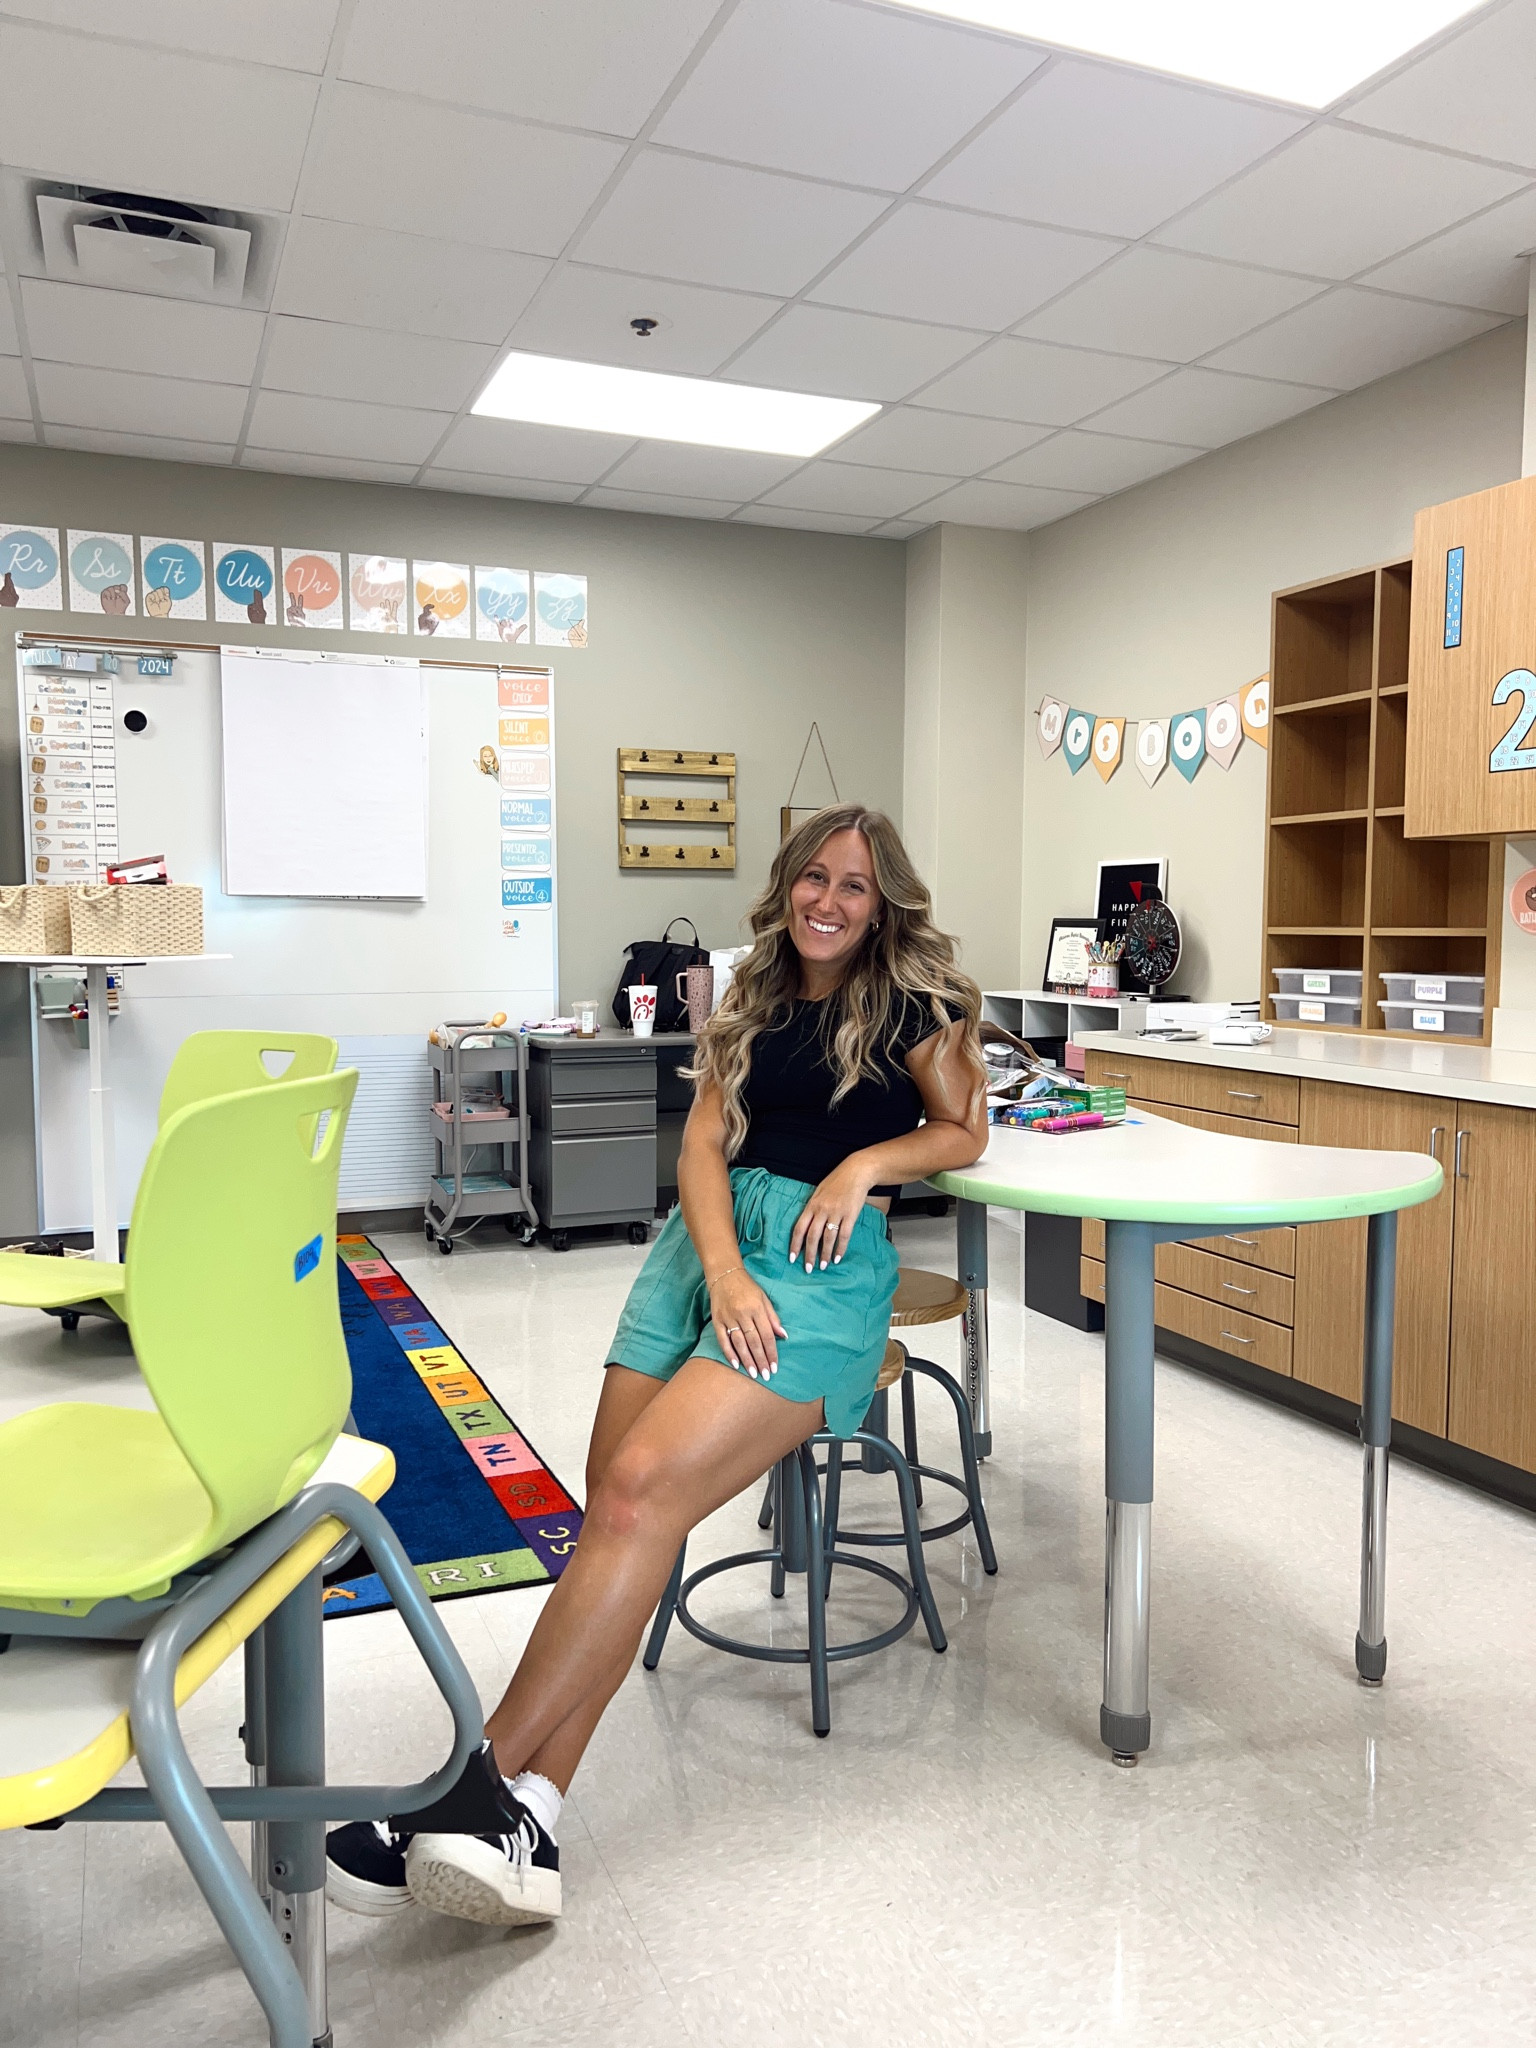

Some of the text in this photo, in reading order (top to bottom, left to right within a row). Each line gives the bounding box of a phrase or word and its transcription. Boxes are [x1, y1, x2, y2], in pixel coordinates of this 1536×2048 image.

[9, 543, 48, 573] Rr
[83, 547, 121, 578] Ss
[159, 556, 186, 585] Tt
[225, 560, 265, 588] Uu
[294, 567, 332, 594] Vv
[488, 580, 521, 617] Yy
[141, 659, 169, 674] 2024
[503, 681, 545, 693] voice
[504, 720, 529, 734] SILENT
[1044, 713, 1110, 752] Mrs
[503, 734, 531, 742] voice
[501, 800, 534, 815] NORMAL
[504, 815, 533, 823] voice
[502, 842, 537, 854] PRESENTER
[505, 854, 533, 863] voice
[503, 880, 536, 894] OUTSIDE
[505, 894, 535, 902] voice
[1111, 903, 1139, 911] HAPP
[1111, 918, 1128, 927] FIR
[1115, 933, 1126, 942] DA
[1306, 980, 1327, 989] GREEN
[1417, 986, 1443, 995] PURPLE
[1419, 1016, 1437, 1025] BLUE
[387, 1303, 413, 1320] WA
[403, 1328, 430, 1345] VA
[419, 1355, 449, 1371] VT
[436, 1382, 469, 1399] UT
[455, 1409, 491, 1431] TX
[478, 1443, 517, 1467] TN
[509, 1483, 547, 1508] SD
[428, 1562, 503, 1586] RI
[323, 1588, 358, 1604] A
